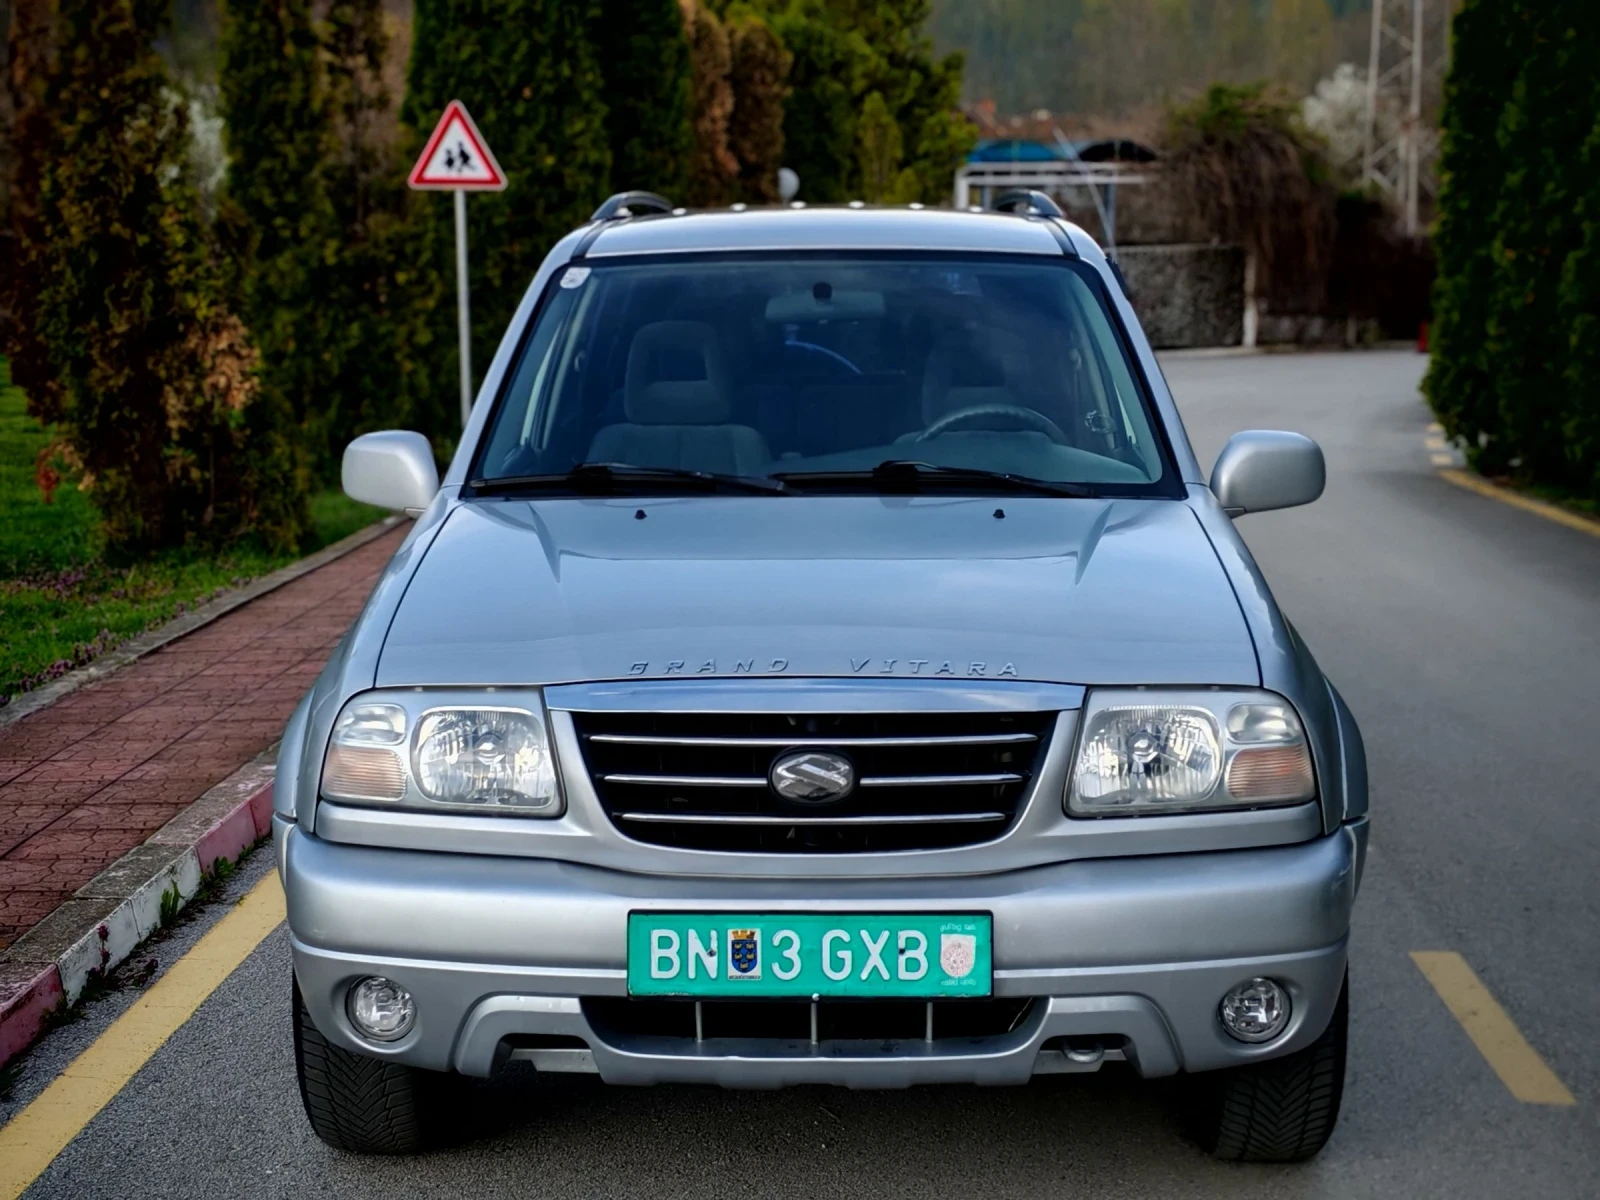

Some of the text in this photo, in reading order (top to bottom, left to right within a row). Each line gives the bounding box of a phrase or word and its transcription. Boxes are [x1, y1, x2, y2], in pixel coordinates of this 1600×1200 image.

[627, 657, 1018, 677] GRAND VITARA
[650, 929, 929, 981] BN 3 GXB
